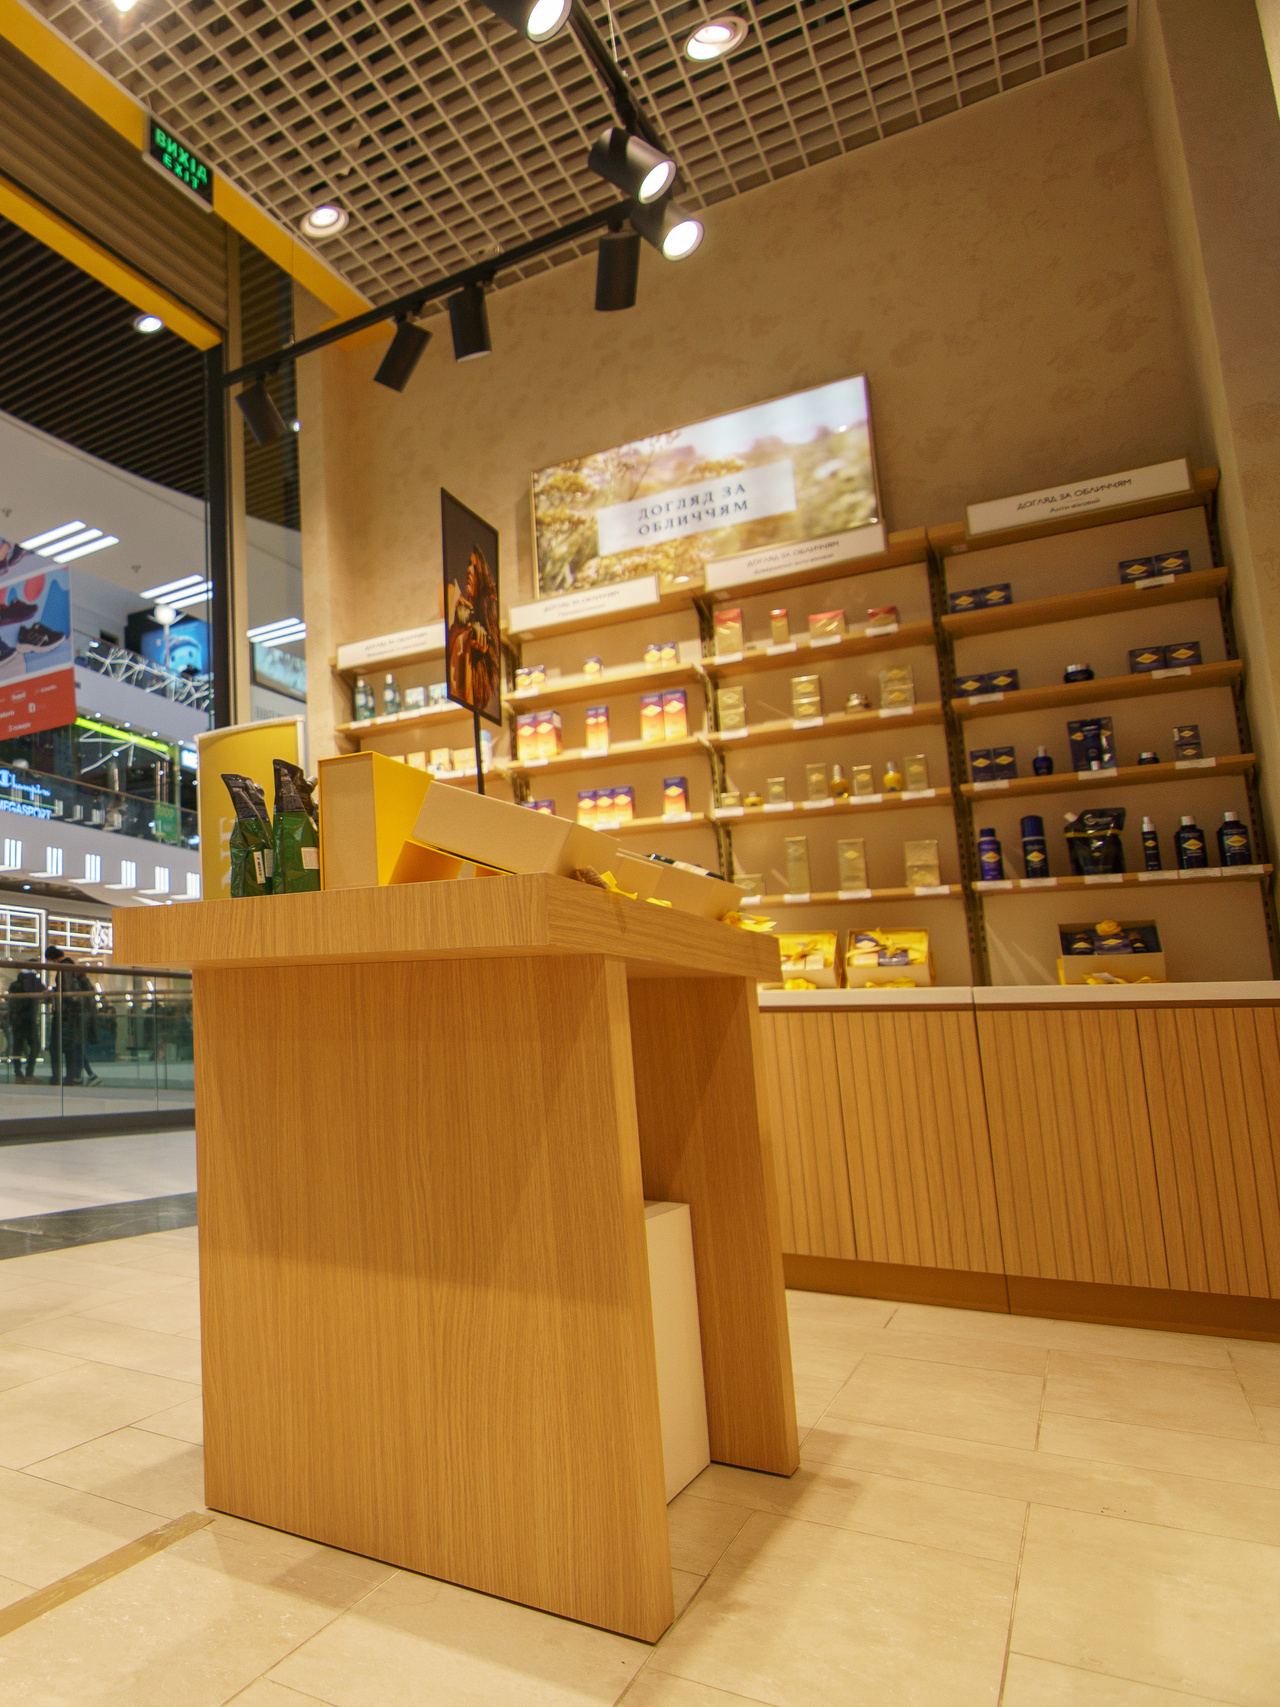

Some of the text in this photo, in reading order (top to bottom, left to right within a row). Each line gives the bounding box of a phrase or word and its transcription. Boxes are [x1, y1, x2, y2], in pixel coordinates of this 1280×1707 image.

[162, 152, 200, 190] EXIT
[639, 484, 745, 522] ДОГЛЯД ЗА
[1074, 479, 1133, 498] ОБЛИЧЧЯМ
[638, 500, 748, 536] ОБЛИЧЧЯМ
